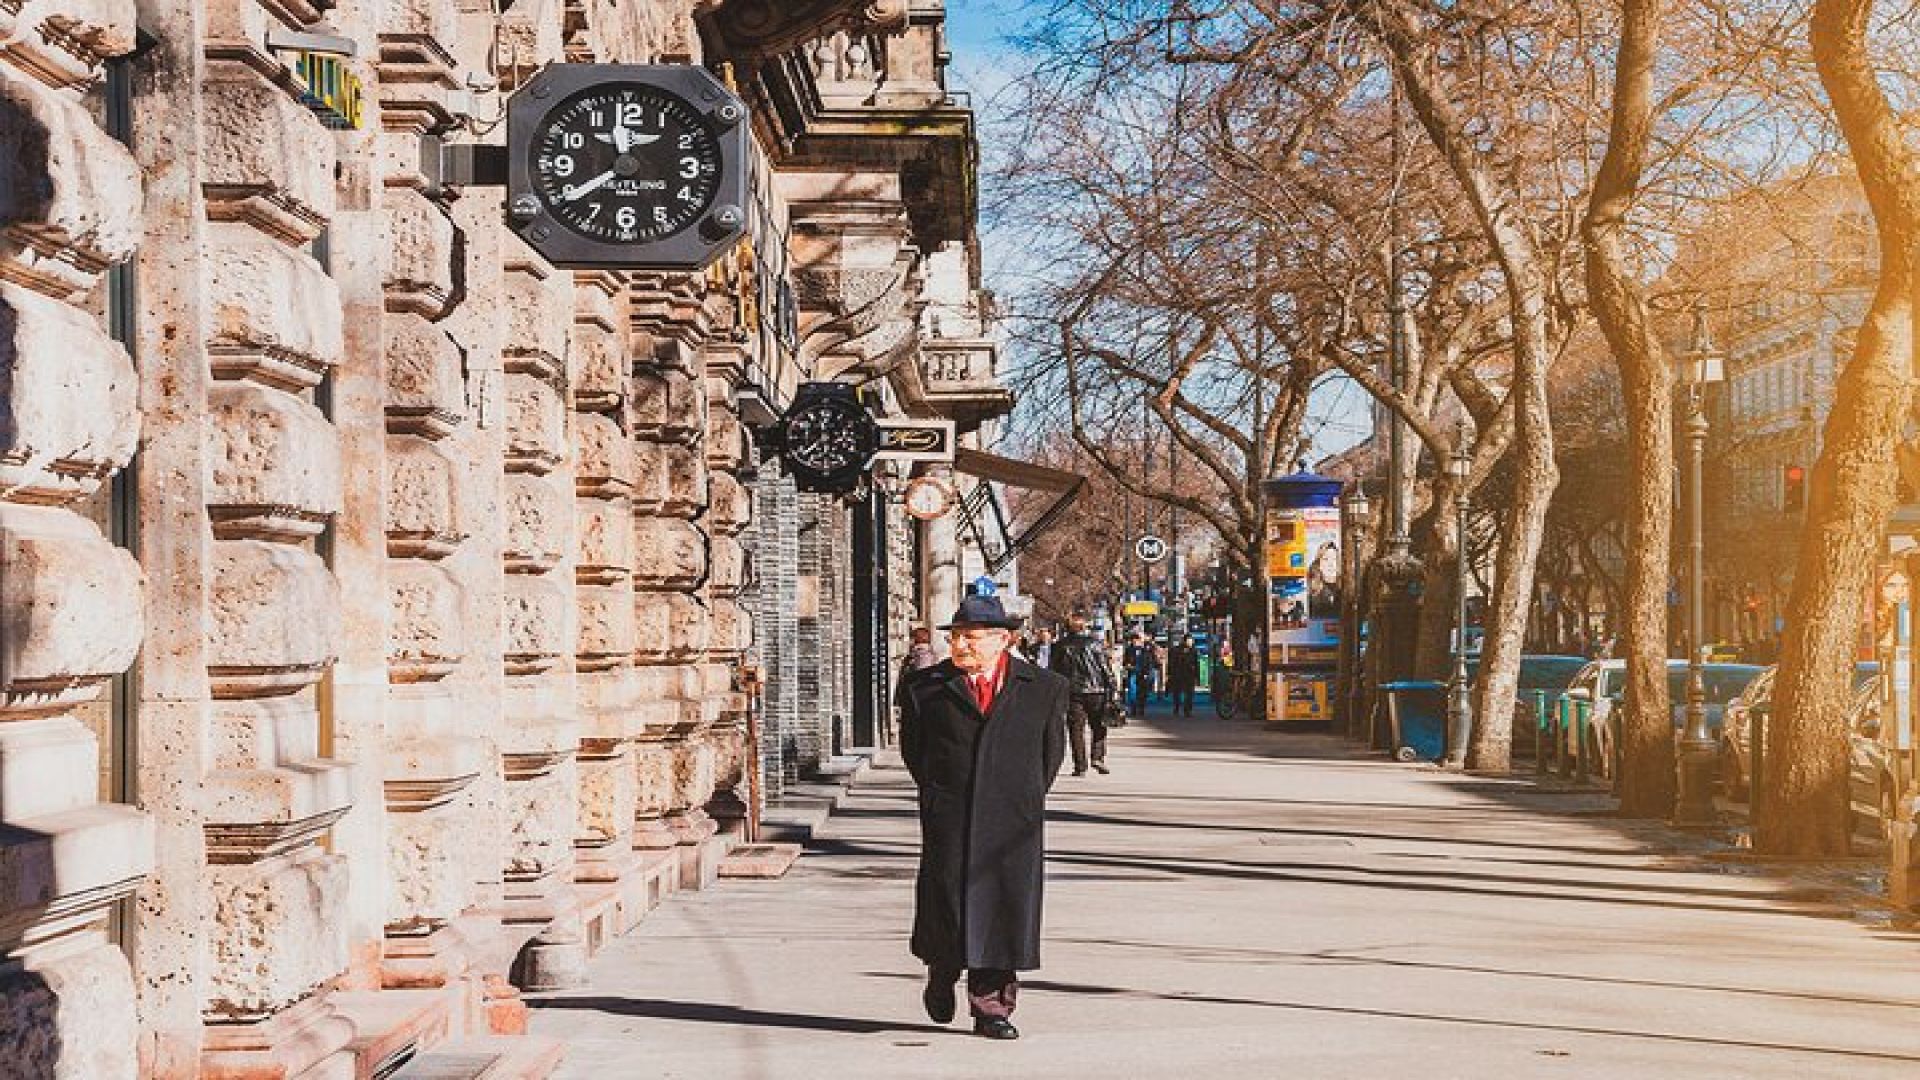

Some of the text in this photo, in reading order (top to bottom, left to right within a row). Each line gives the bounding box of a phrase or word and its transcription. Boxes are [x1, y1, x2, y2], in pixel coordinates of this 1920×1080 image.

[591, 110, 603, 126] 11
[616, 103, 643, 125] 12
[659, 111, 665, 128] 1
[562, 132, 584, 149] 10
[677, 134, 692, 149] 2
[555, 155, 574, 176] 9
[680, 157, 699, 178] 3
[677, 186, 693, 201] 4
[588, 203, 600, 218] 7
[616, 207, 635, 228] 6
[653, 207, 667, 222] 5
[1143, 541, 1158, 555] M
